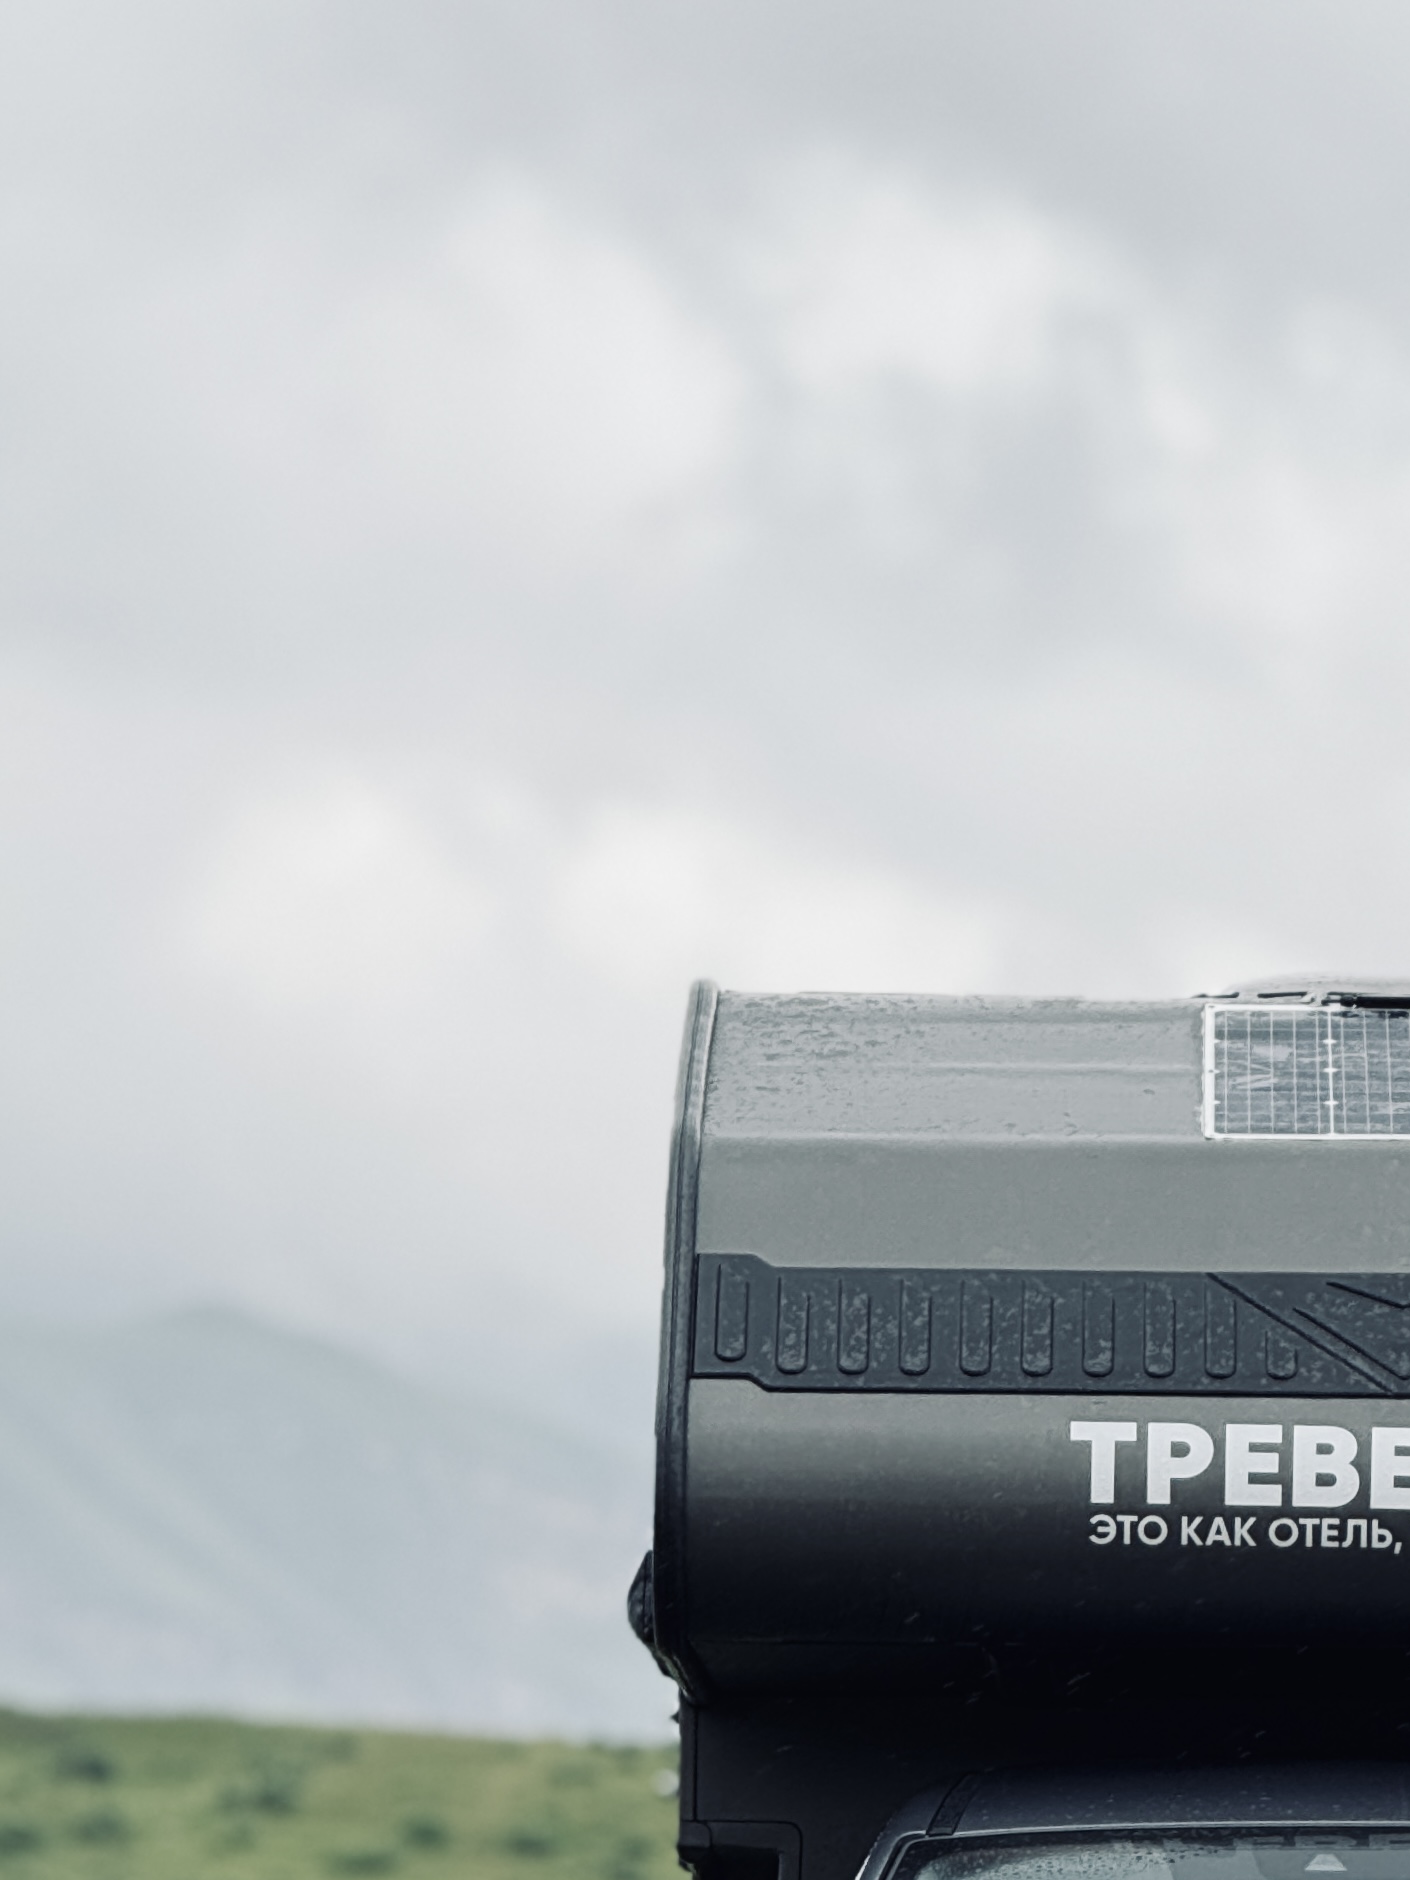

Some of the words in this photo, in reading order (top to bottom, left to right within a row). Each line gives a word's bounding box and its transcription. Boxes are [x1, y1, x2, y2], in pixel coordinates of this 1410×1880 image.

[1088, 1513, 1168, 1546] ЭТО
[1180, 1515, 1257, 1547] КАК
[1268, 1517, 1402, 1554] ОТЕЛЬ,
